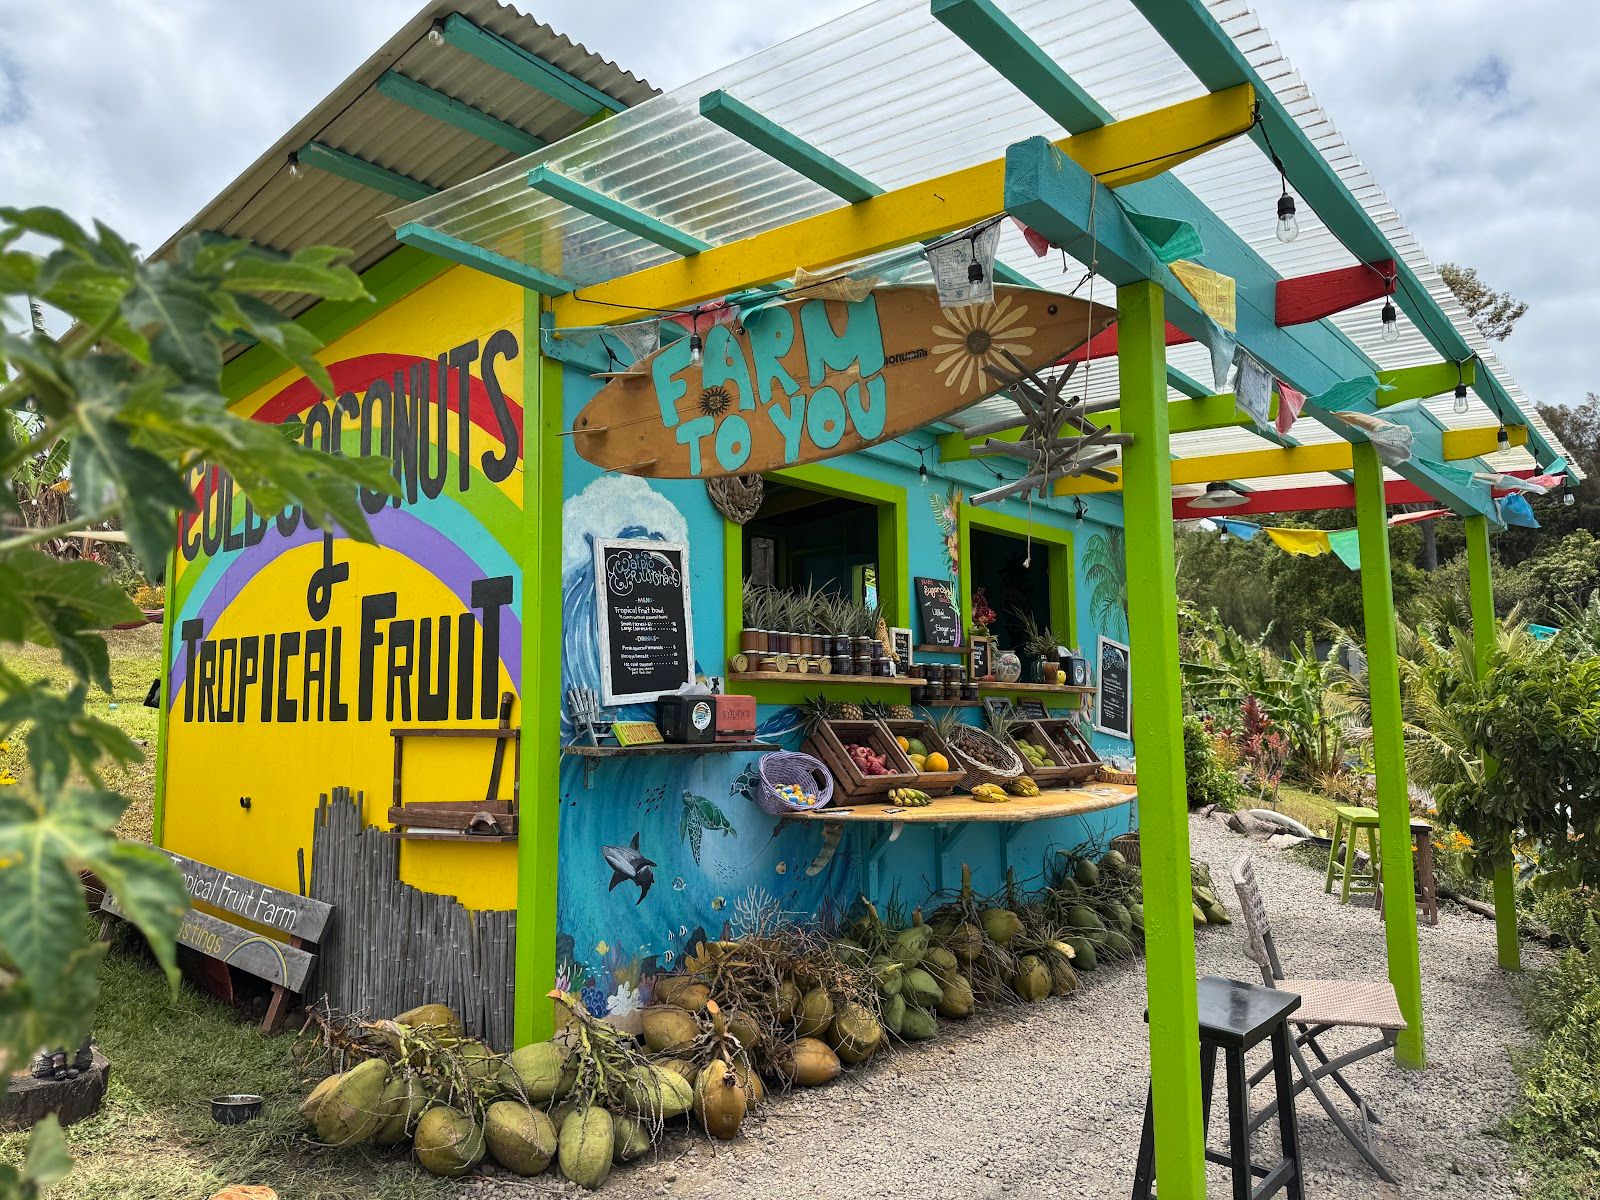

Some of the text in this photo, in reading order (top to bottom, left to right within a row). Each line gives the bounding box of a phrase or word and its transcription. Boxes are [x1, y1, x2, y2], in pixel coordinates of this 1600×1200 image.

[652, 293, 886, 428] FARM
[676, 372, 887, 476] TO YOU
[614, 606, 637, 615] Tropical
[216, 875, 255, 914] Fruit
[254, 888, 297, 930] Farm
[177, 921, 224, 954] stings
